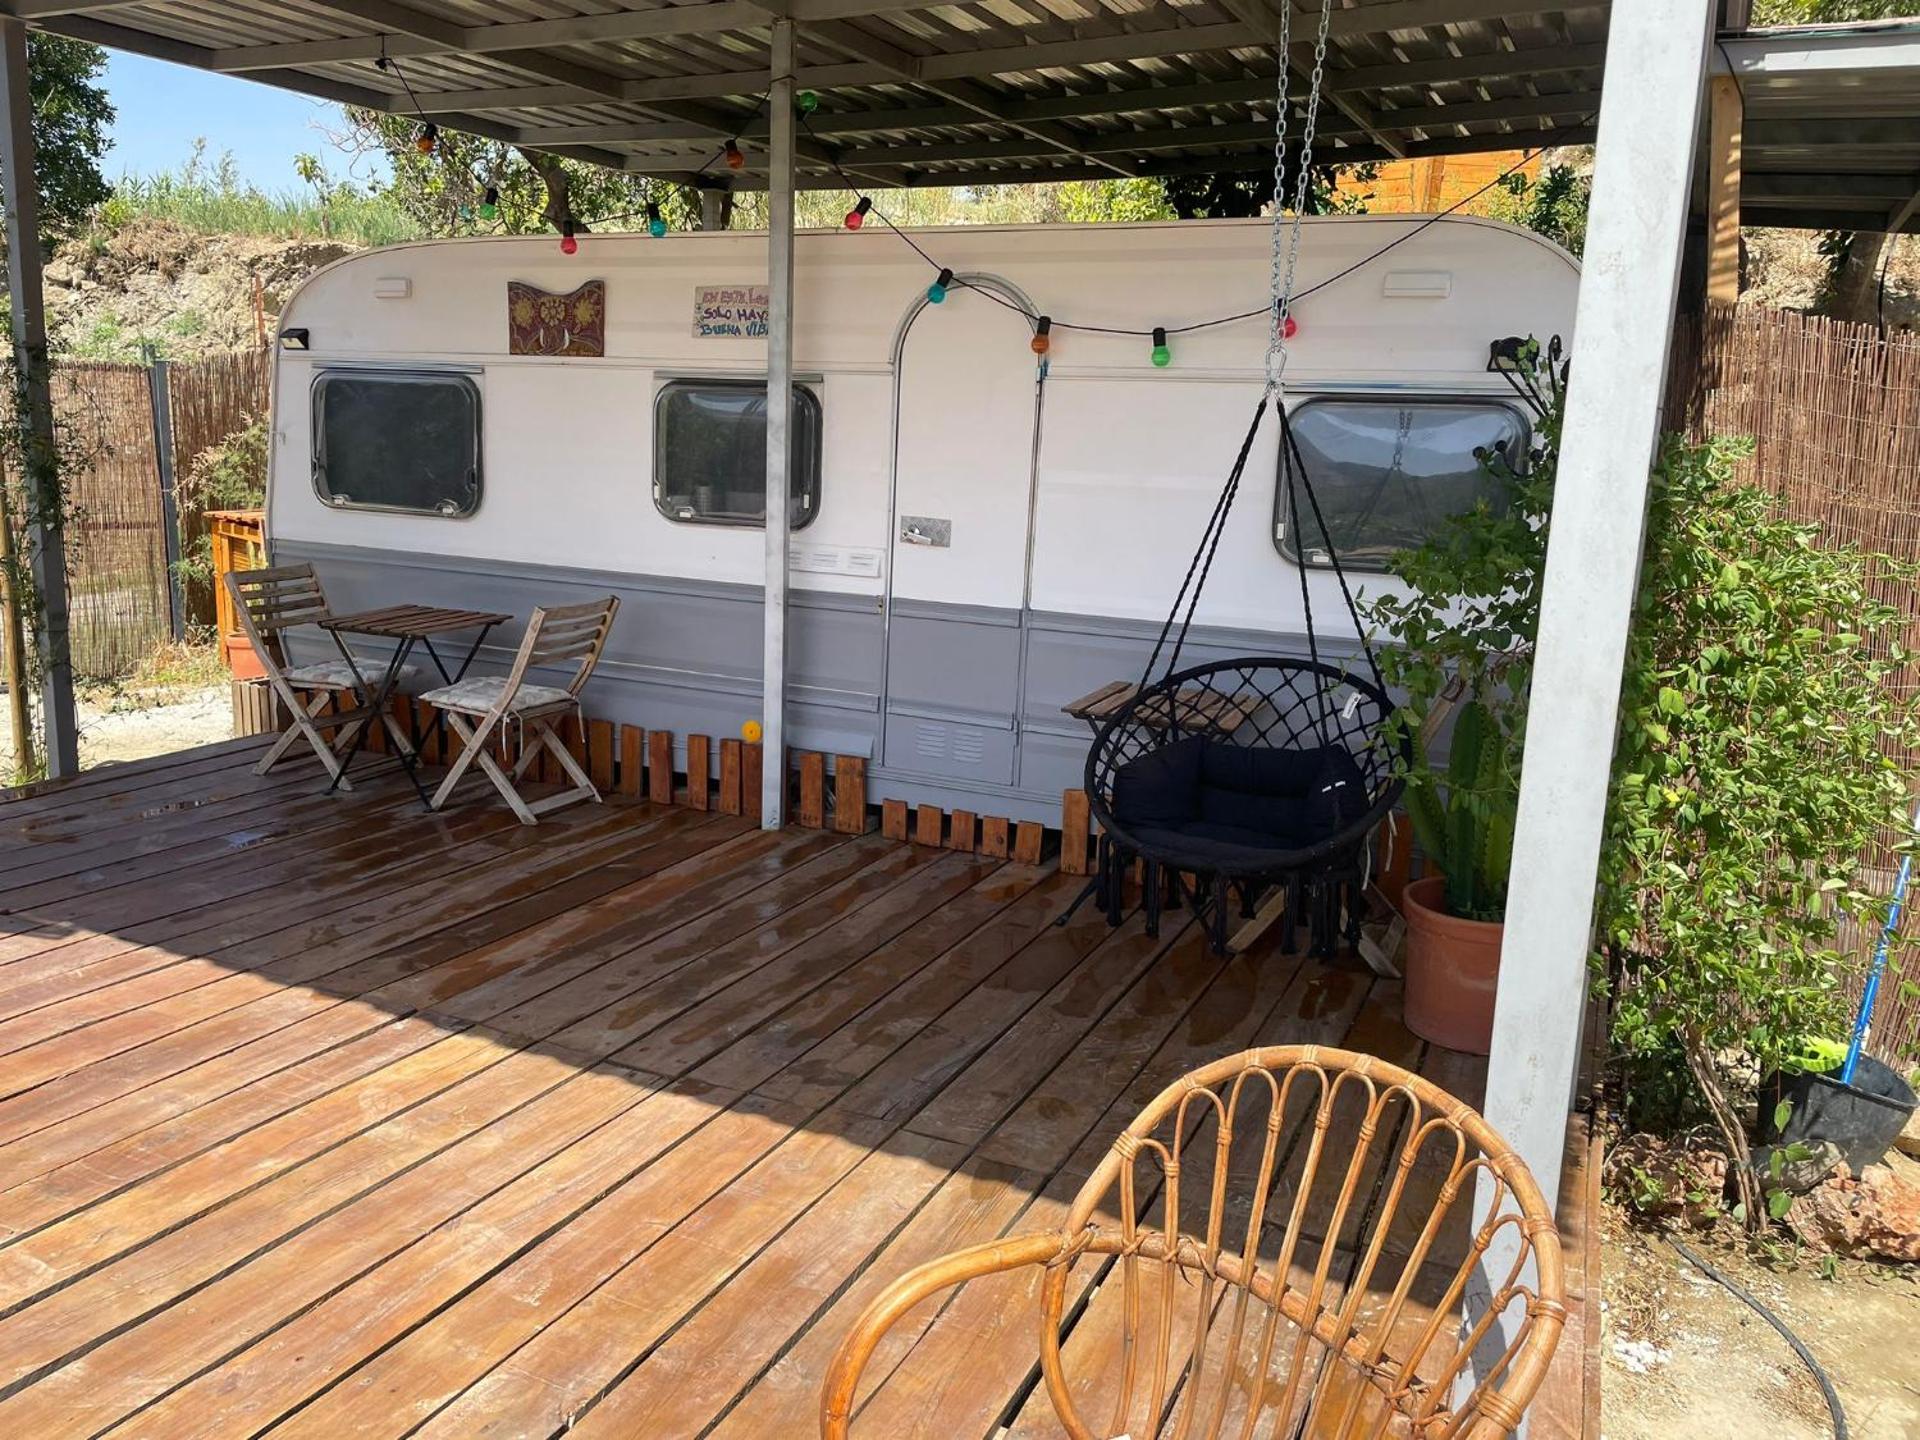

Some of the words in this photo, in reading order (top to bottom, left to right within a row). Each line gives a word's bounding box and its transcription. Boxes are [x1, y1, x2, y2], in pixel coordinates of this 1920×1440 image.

[703, 305, 732, 320] SOLO
[700, 323, 741, 336] BUENA
[746, 321, 769, 337] VIB
